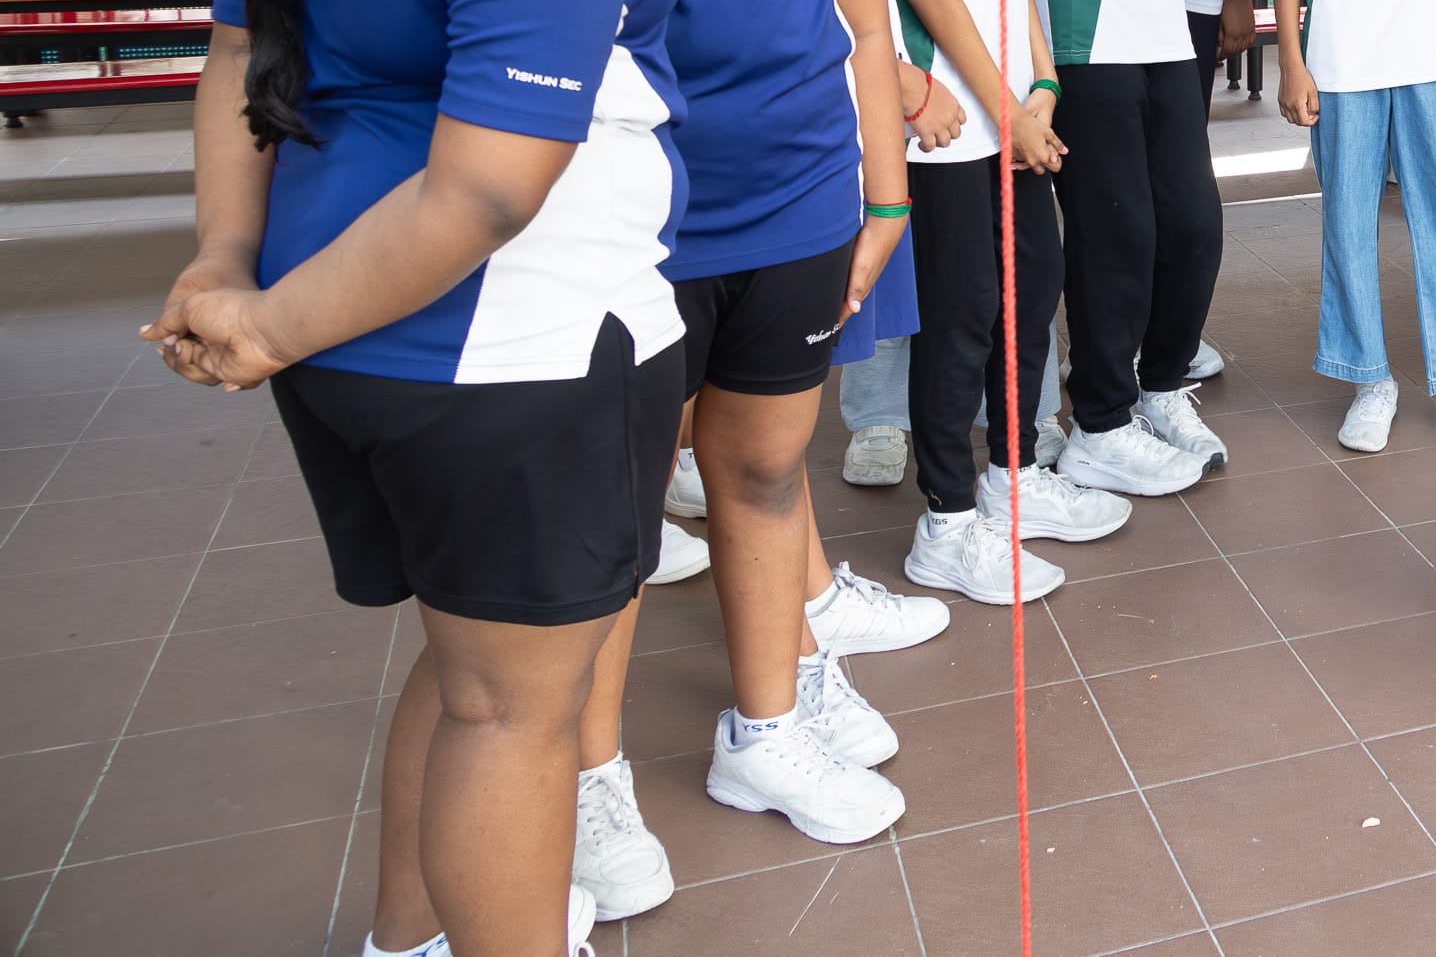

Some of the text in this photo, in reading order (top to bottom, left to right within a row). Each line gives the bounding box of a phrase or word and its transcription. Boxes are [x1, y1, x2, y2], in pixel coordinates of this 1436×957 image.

[506, 67, 582, 91] YISHUN SEC
[742, 721, 779, 732] YSS
